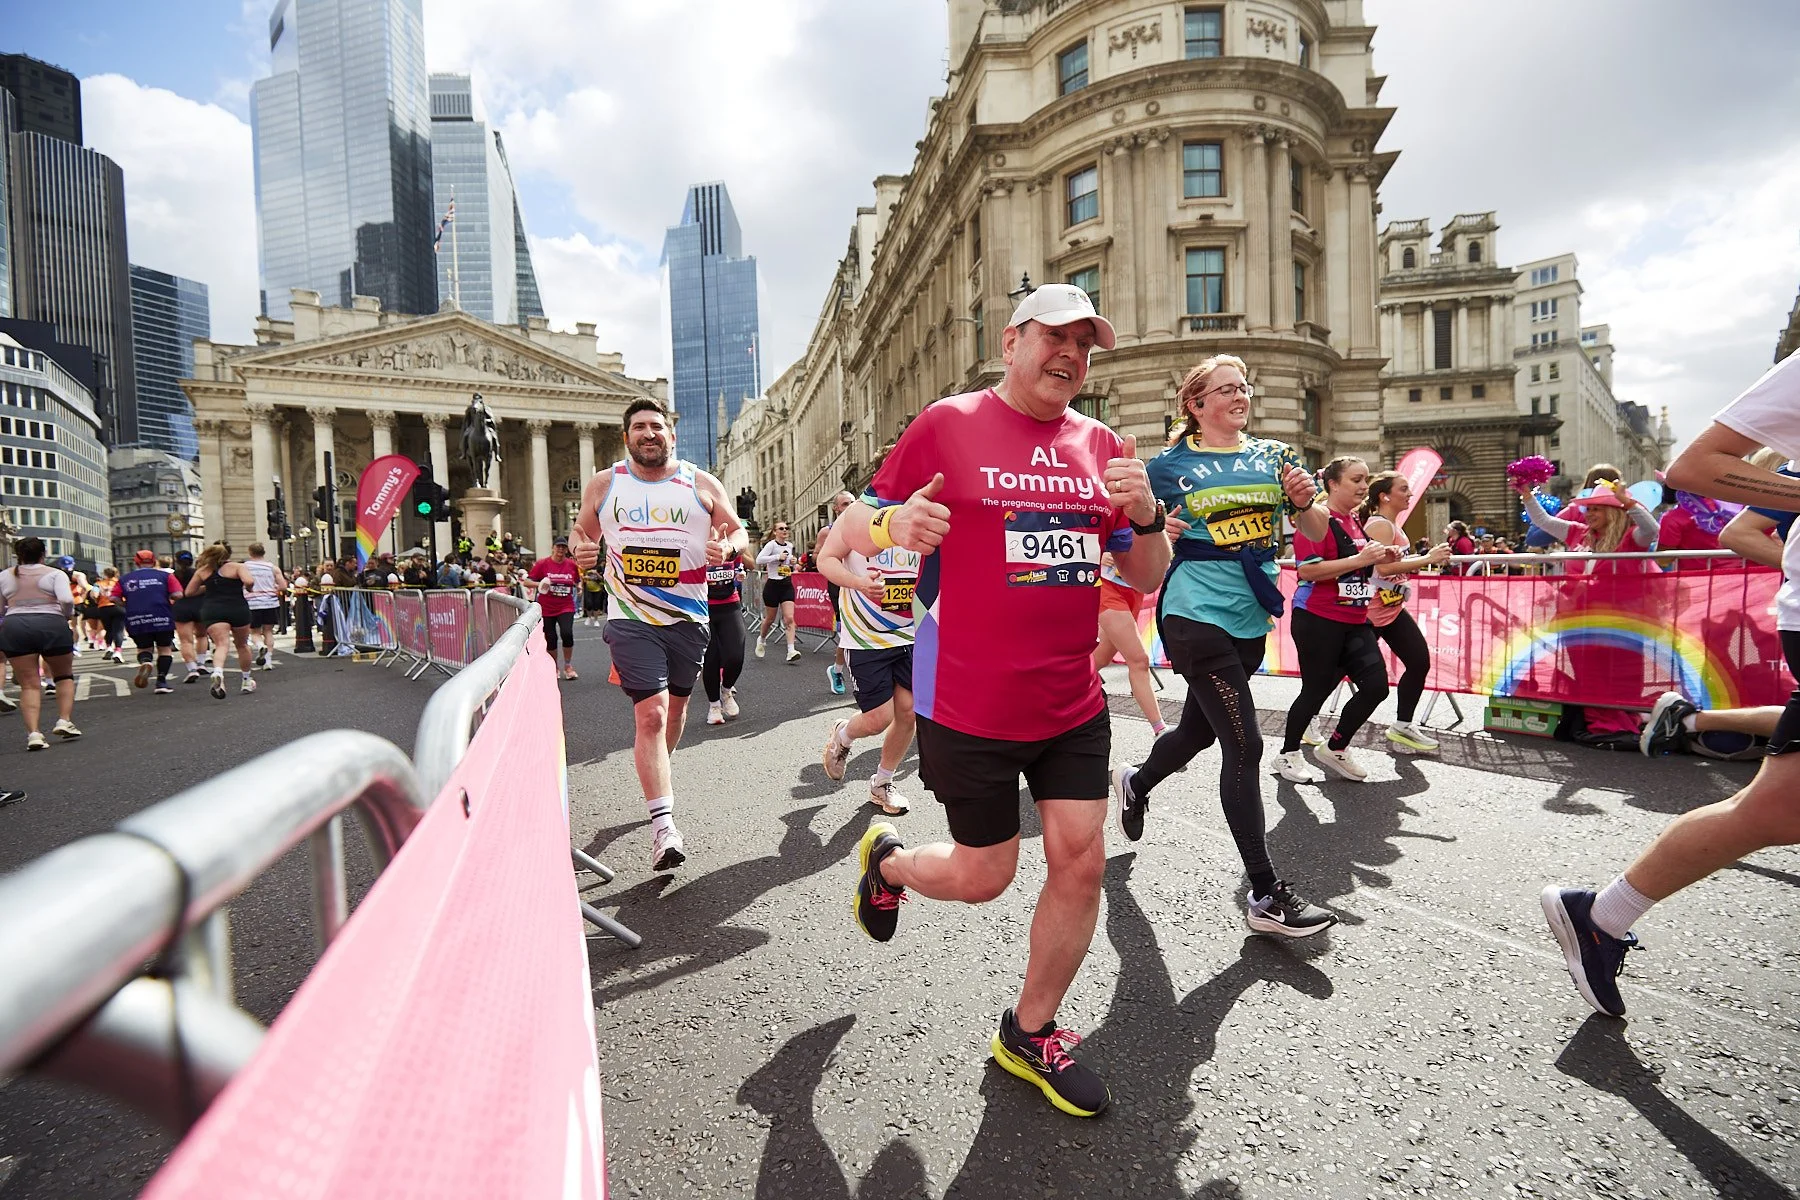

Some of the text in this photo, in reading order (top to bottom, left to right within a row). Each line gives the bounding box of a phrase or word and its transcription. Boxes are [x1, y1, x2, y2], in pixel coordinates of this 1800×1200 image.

[1030, 445, 1069, 468] AL
[365, 467, 403, 516] Tommy's
[979, 466, 1112, 500] Tommy's
[613, 493, 691, 526] halow
[981, 498, 1112, 517] The pregnancy and baby charity
[1229, 507, 1254, 517] CHIARA
[1049, 516, 1062, 524] AL
[1215, 514, 1272, 540] 14118
[618, 535, 689, 545] nurturing independence
[1022, 533, 1087, 560] 9461
[626, 558, 677, 574] 13640
[866, 547, 919, 568] alow
[707, 570, 733, 580] 10488
[886, 587, 915, 600] 1296
[1428, 644, 1461, 658] harity
[1766, 658, 1790, 672] Th
